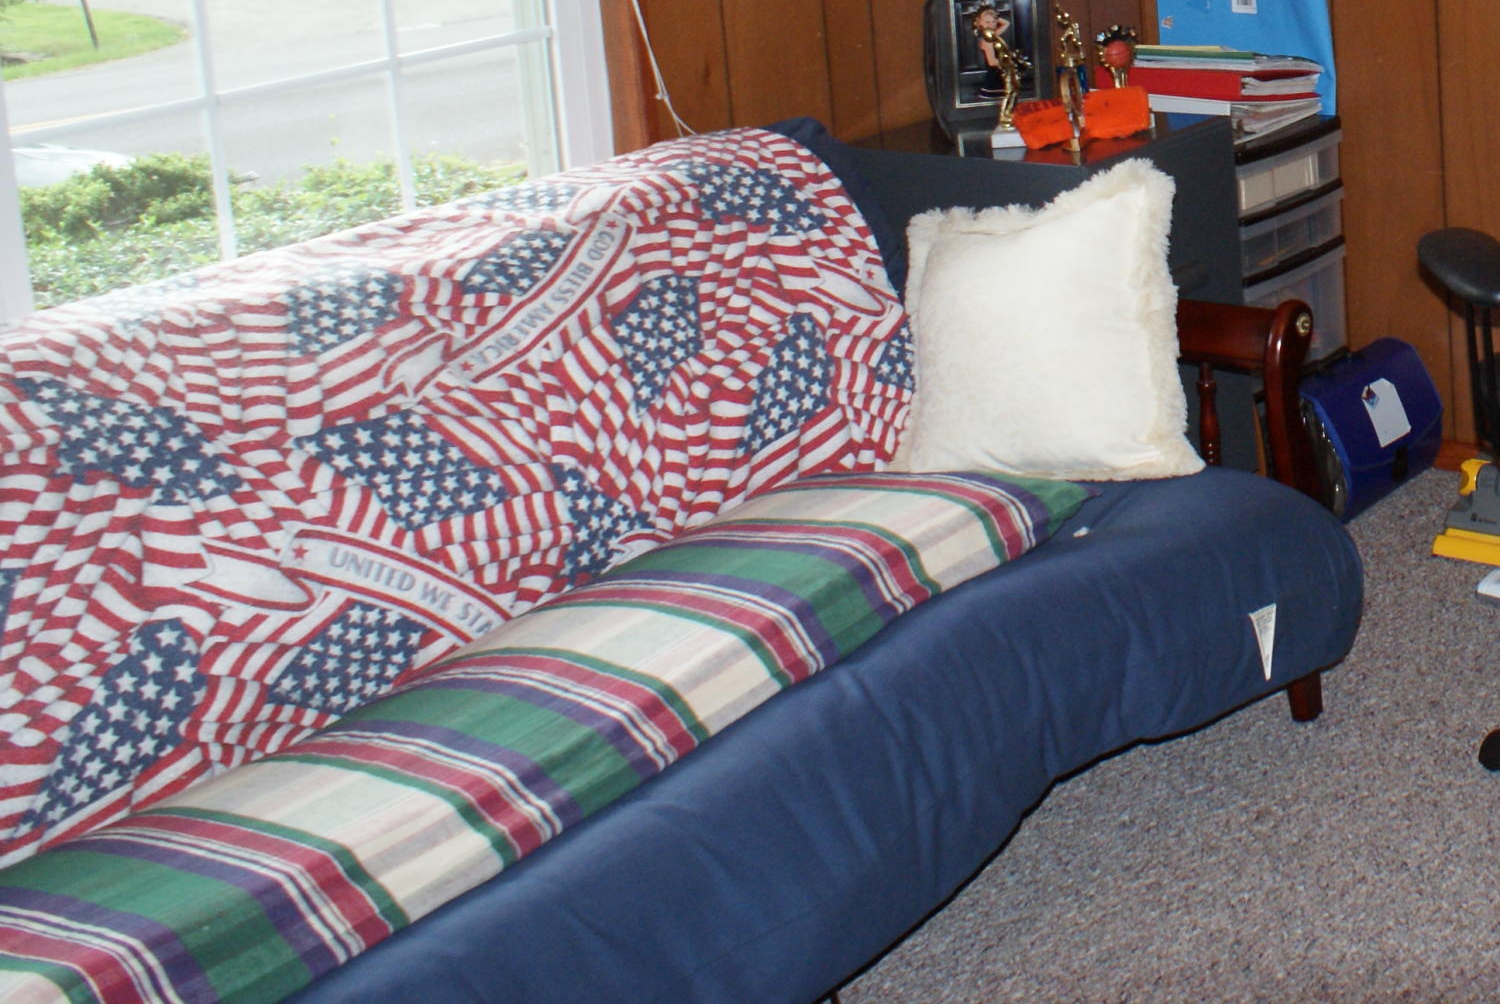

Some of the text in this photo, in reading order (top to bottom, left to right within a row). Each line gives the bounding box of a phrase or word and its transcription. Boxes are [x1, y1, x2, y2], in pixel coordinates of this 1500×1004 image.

[473, 230, 616, 366] GOD BLESS AMERICA
[328, 546, 417, 592] UNITED
[418, 580, 456, 612] WE
